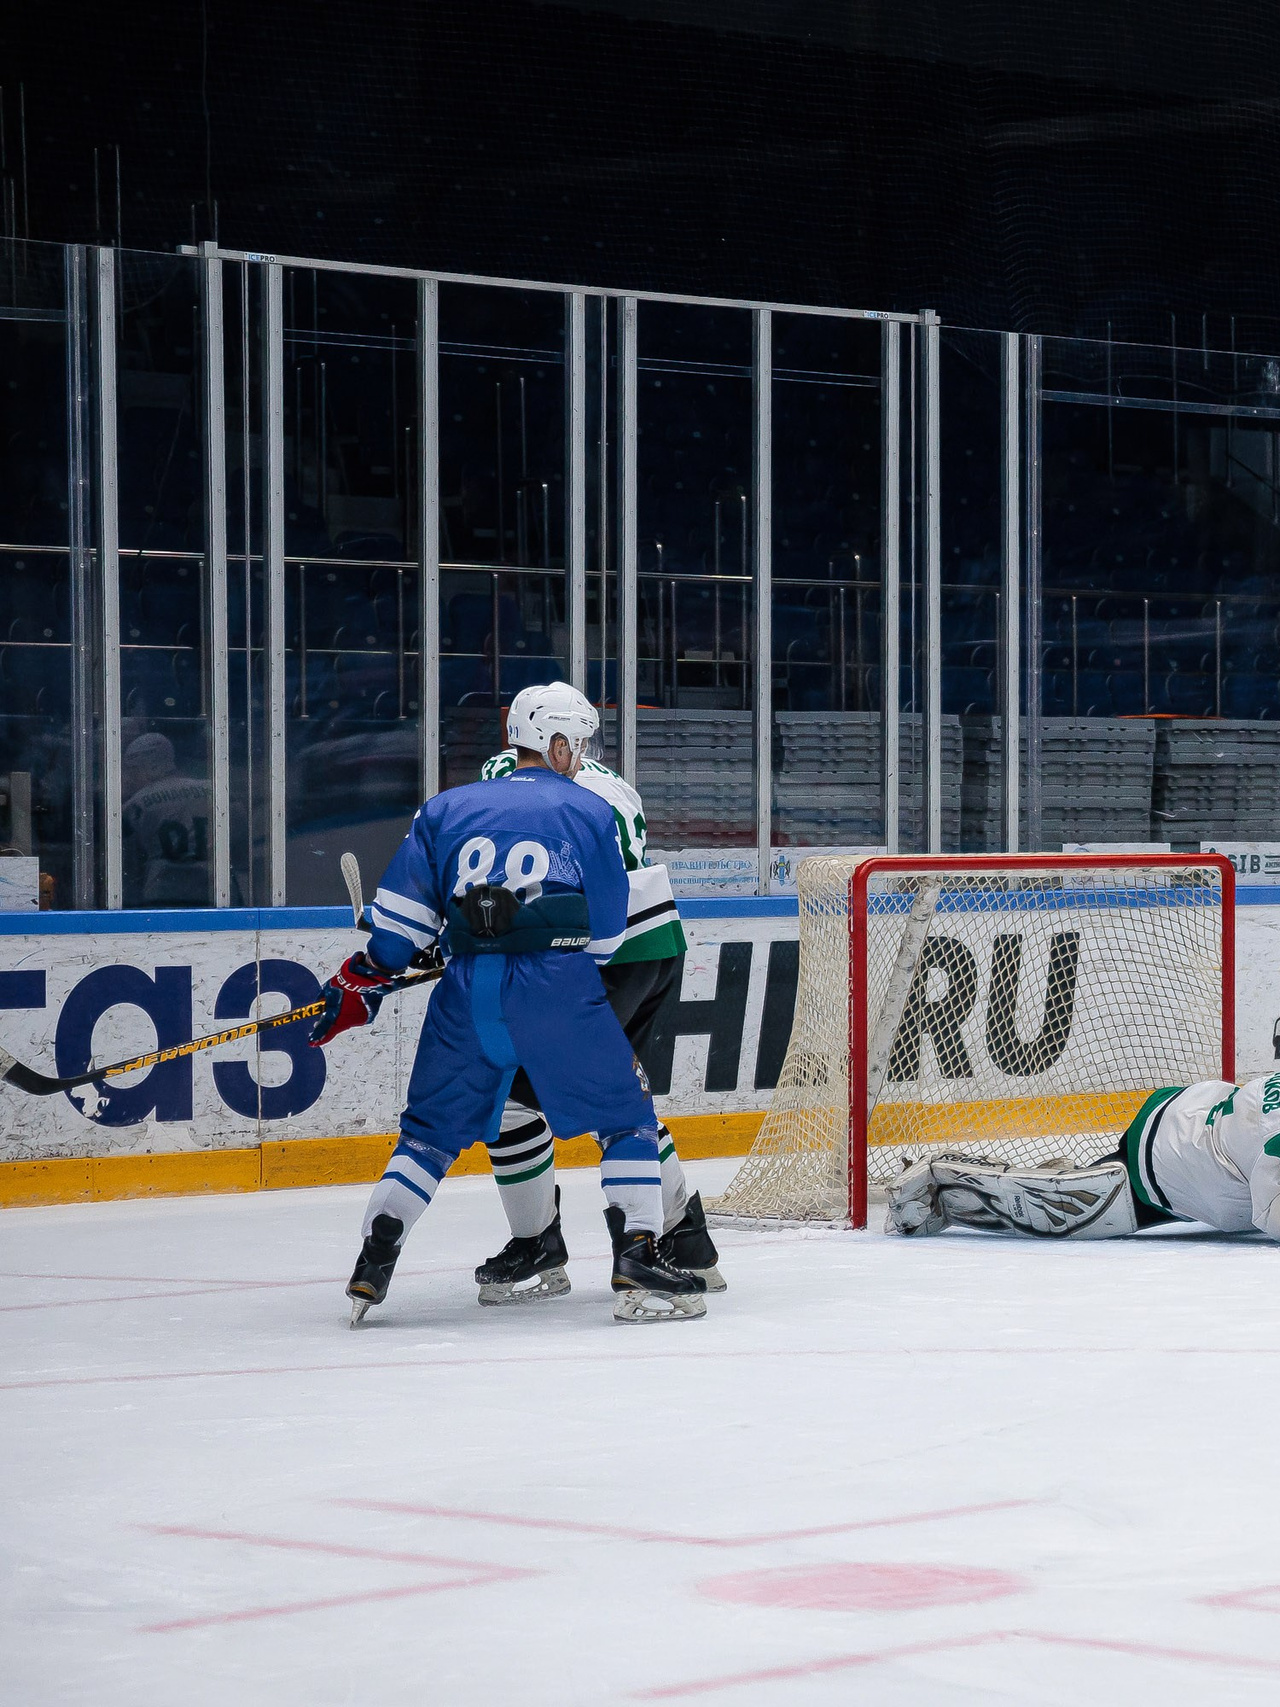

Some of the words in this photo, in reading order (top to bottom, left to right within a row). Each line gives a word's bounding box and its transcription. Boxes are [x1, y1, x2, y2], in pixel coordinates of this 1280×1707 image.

[452, 836, 550, 904] 88
[550, 936, 591, 948] BAUER
[104, 1022, 258, 1079] SHERWOOD
